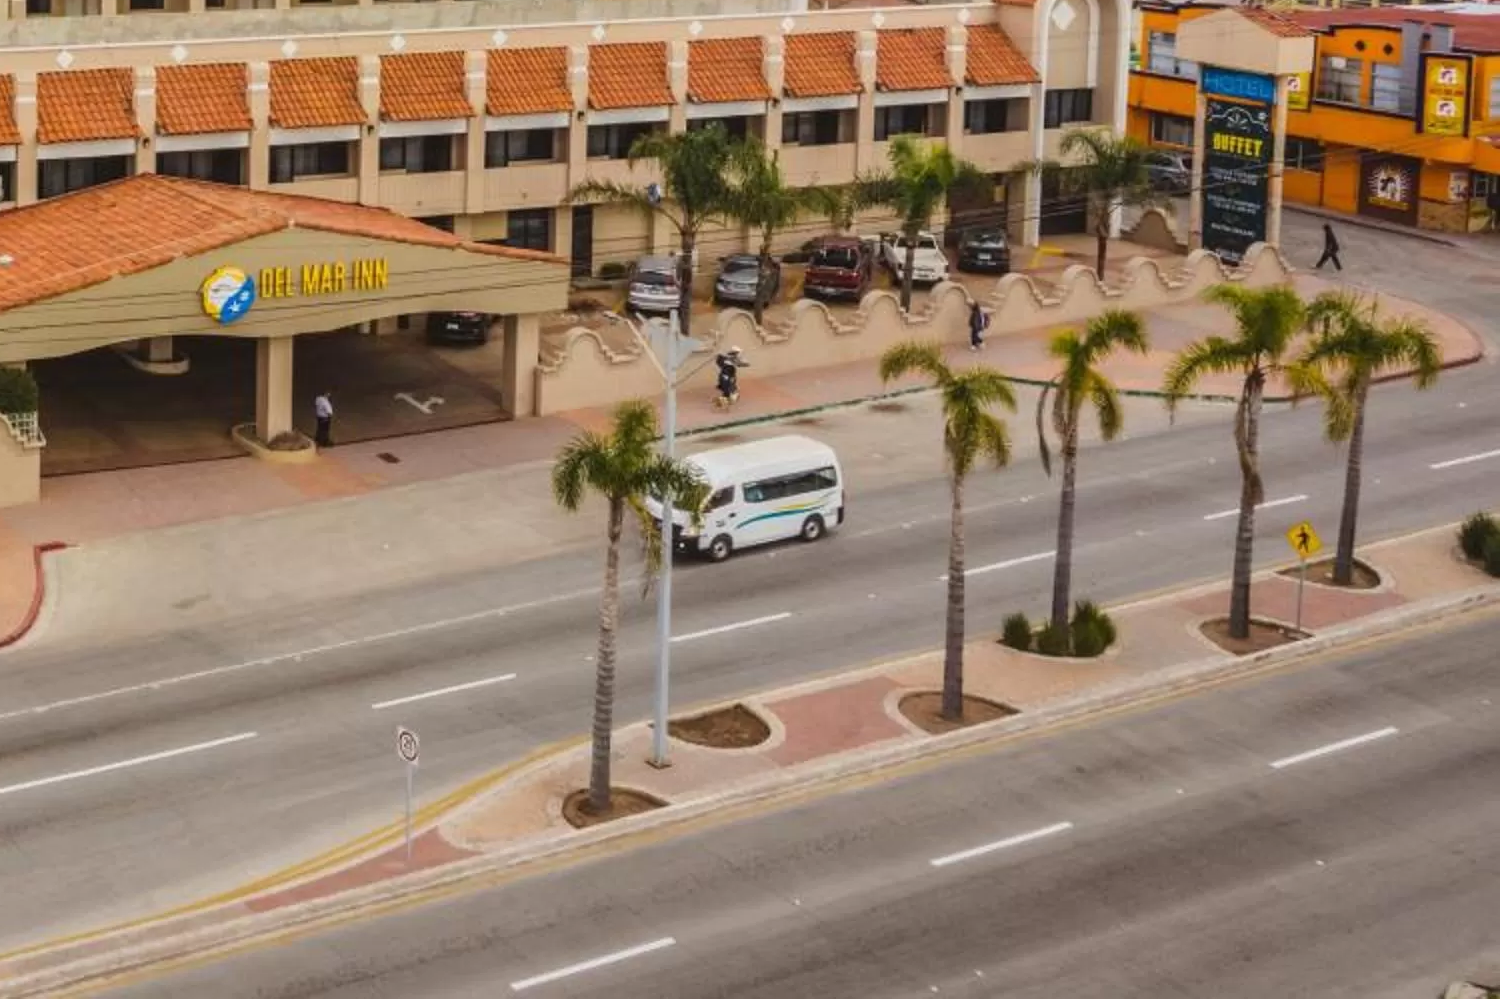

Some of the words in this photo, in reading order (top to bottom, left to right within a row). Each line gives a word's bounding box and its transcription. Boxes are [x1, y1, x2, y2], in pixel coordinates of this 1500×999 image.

[1203, 73, 1270, 98] HOTEL
[1213, 132, 1263, 157] BUFFET
[260, 267, 294, 298] DEL
[301, 262, 346, 296] MAR
[352, 257, 388, 290] INN
